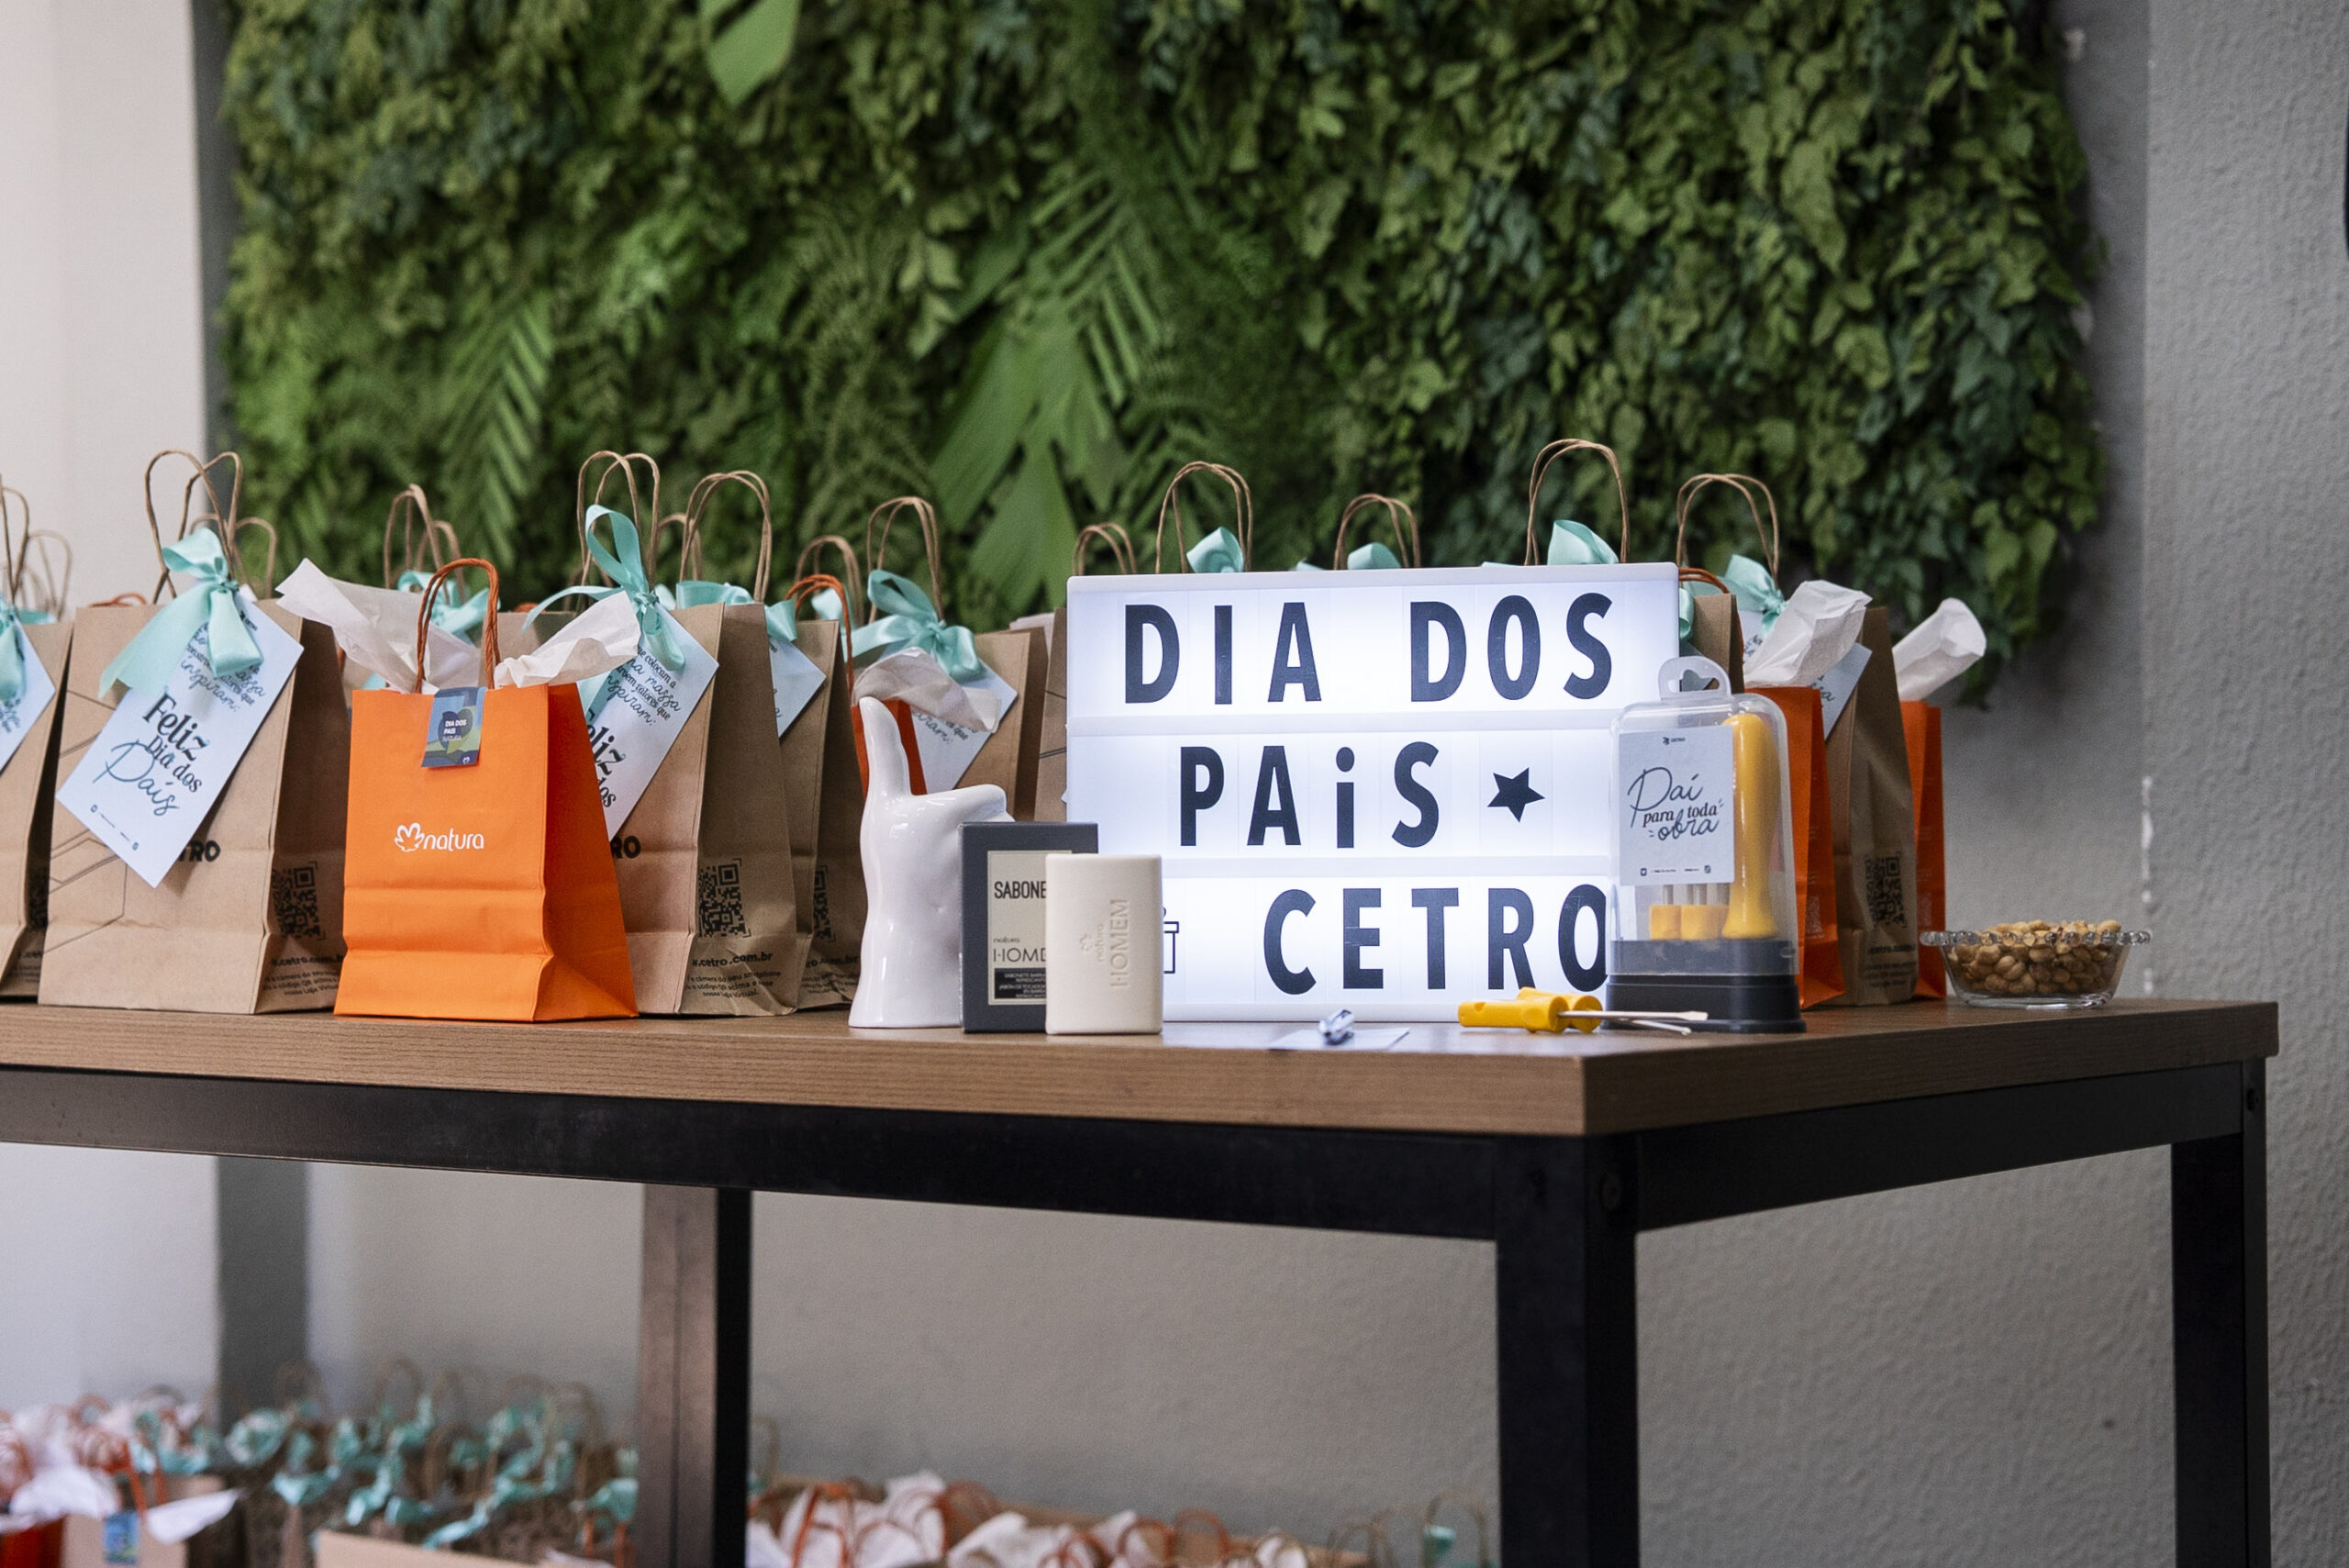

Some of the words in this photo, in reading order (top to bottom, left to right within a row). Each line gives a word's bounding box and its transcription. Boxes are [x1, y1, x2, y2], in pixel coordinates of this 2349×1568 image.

[1124, 602, 1322, 705] DIA
[1409, 592, 1613, 703] DOS
[142, 687, 211, 762] Feliz
[144, 734, 175, 770] Dia
[172, 763, 203, 794] dos
[1642, 809, 1675, 828] para
[1687, 801, 1718, 819] toda
[1657, 808, 1720, 841] obra
[422, 828, 485, 852] natura
[994, 881, 1046, 899] SABONE
[993, 947, 1046, 962] HOME
[1108, 898, 1130, 987] HOMEM
[1264, 884, 1607, 995] CETRO
